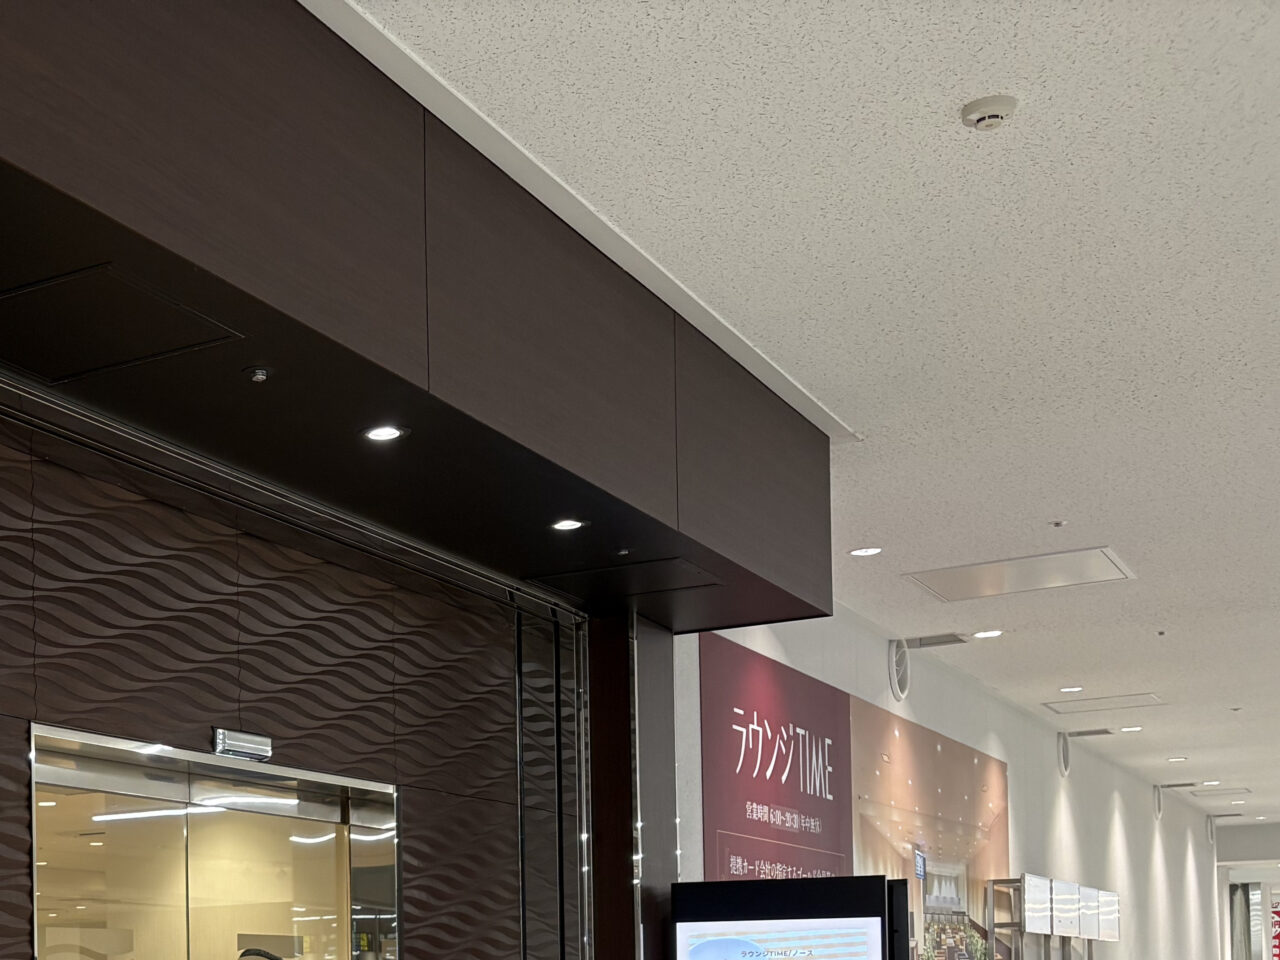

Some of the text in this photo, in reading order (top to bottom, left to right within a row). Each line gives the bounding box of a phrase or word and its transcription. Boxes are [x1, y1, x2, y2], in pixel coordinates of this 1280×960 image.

[732, 707, 833, 800] ラウンジTIME
[745, 801, 769, 823] 営業時間
